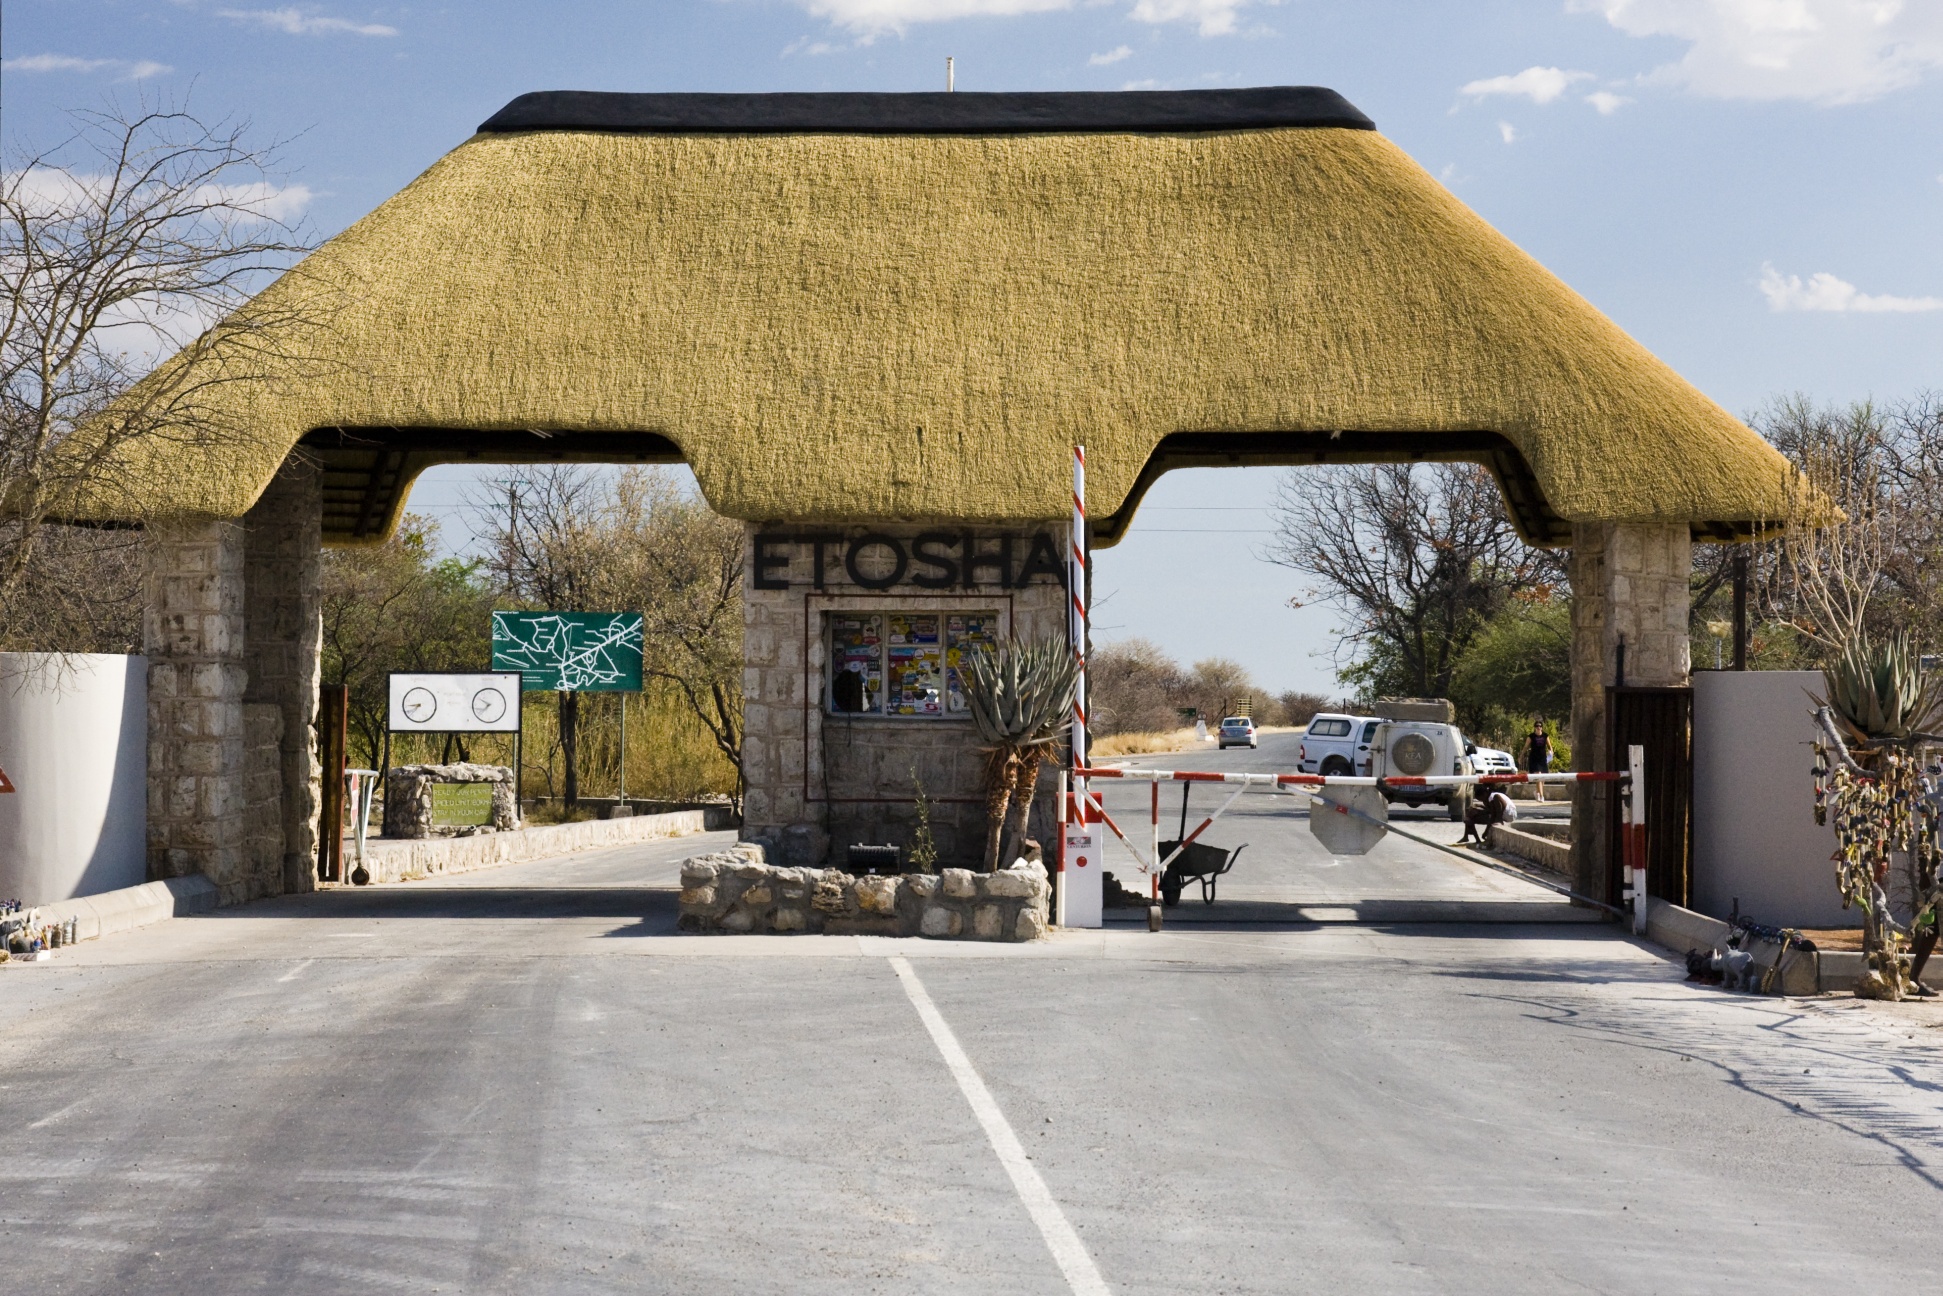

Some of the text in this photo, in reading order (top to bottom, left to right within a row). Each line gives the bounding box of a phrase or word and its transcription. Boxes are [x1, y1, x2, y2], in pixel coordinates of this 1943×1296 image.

[753, 532, 1068, 590] ETOSHA
[1405, 752, 1421, 760] KEA
[433, 799, 455, 807] SPEED
[433, 809, 448, 817] STAY
